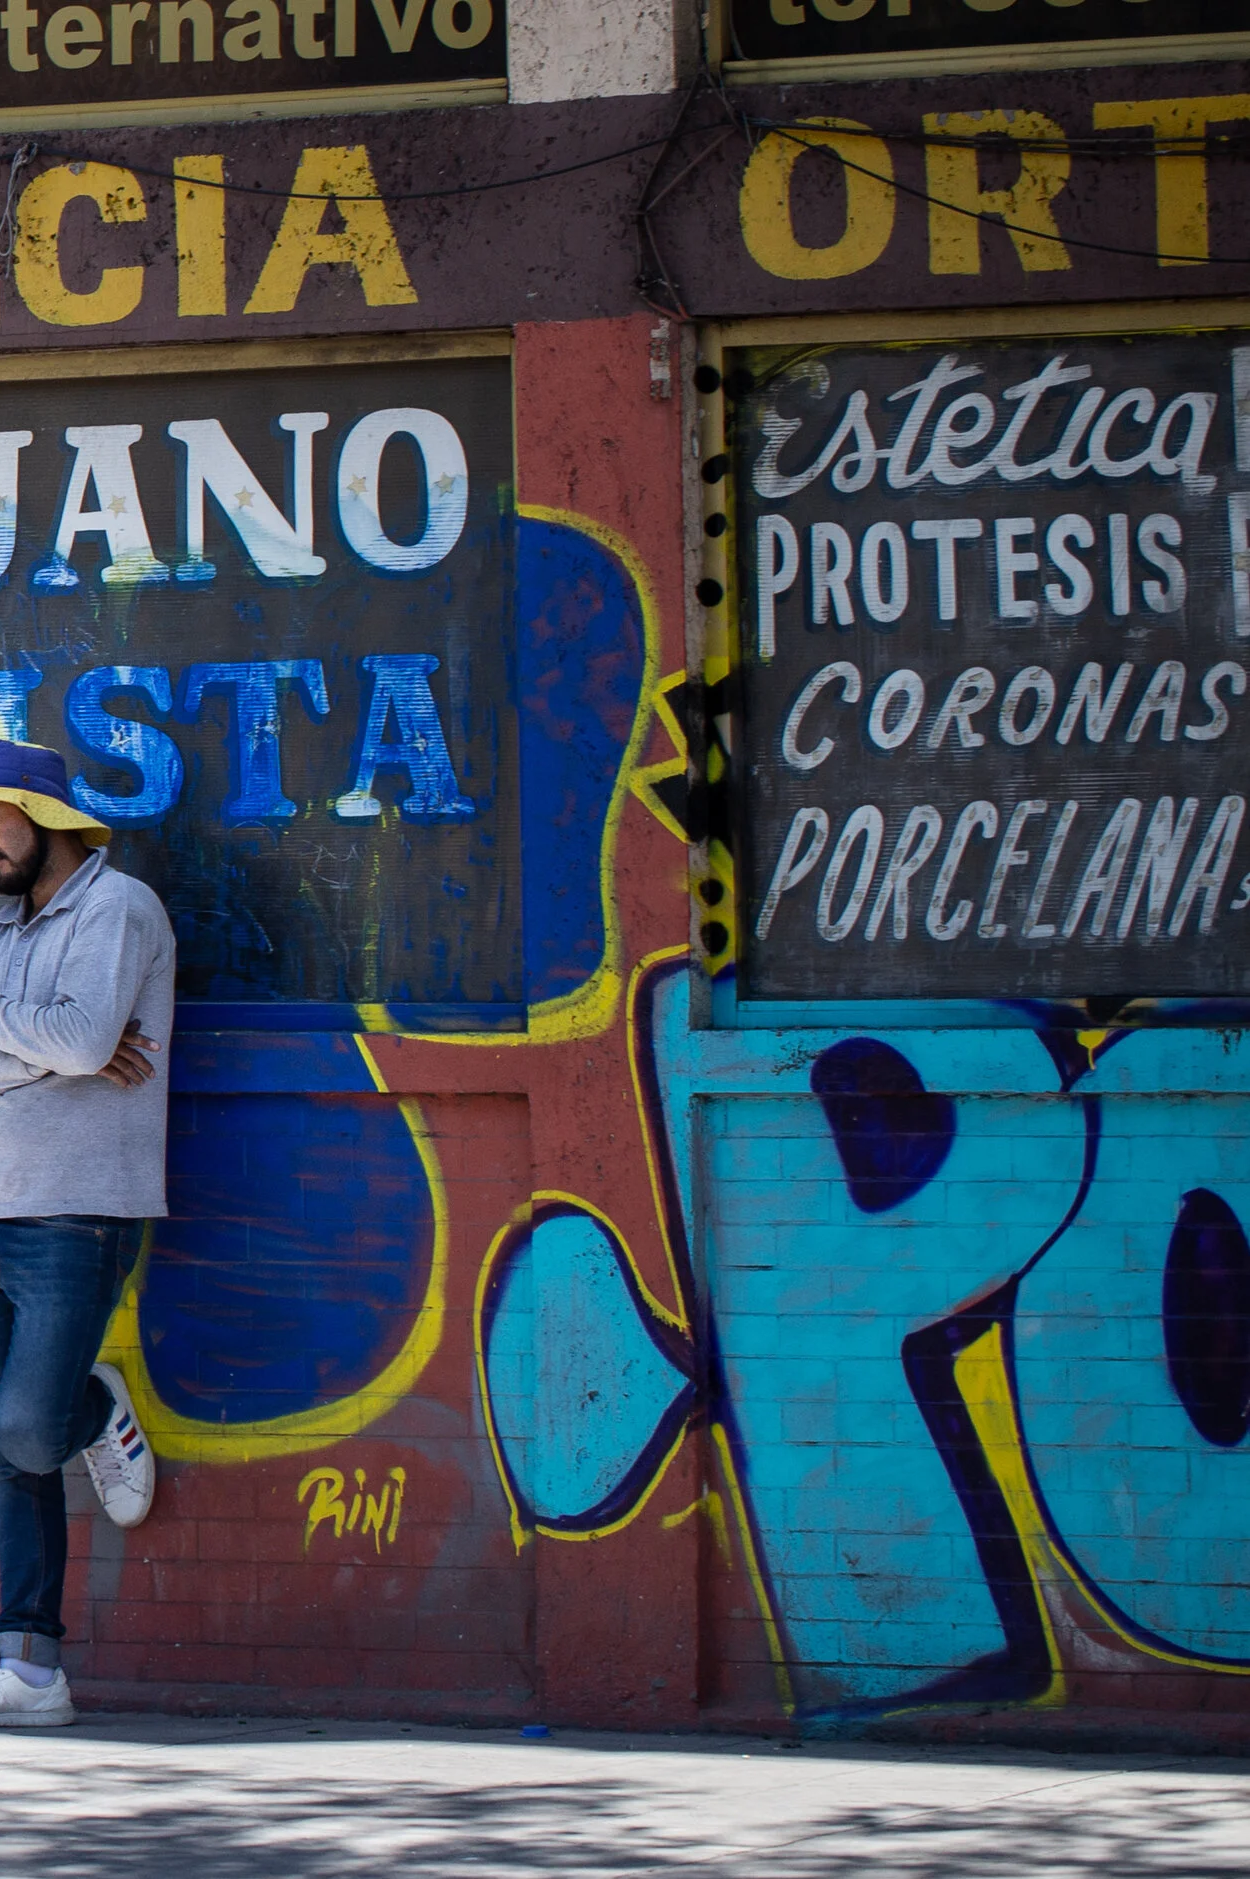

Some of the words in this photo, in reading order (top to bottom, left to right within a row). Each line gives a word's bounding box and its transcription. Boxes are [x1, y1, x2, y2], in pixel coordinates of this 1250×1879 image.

[751, 352, 1218, 498] Estetica
[756, 513, 1187, 658] PROTESIS
[781, 660, 1248, 771] CORONAS
